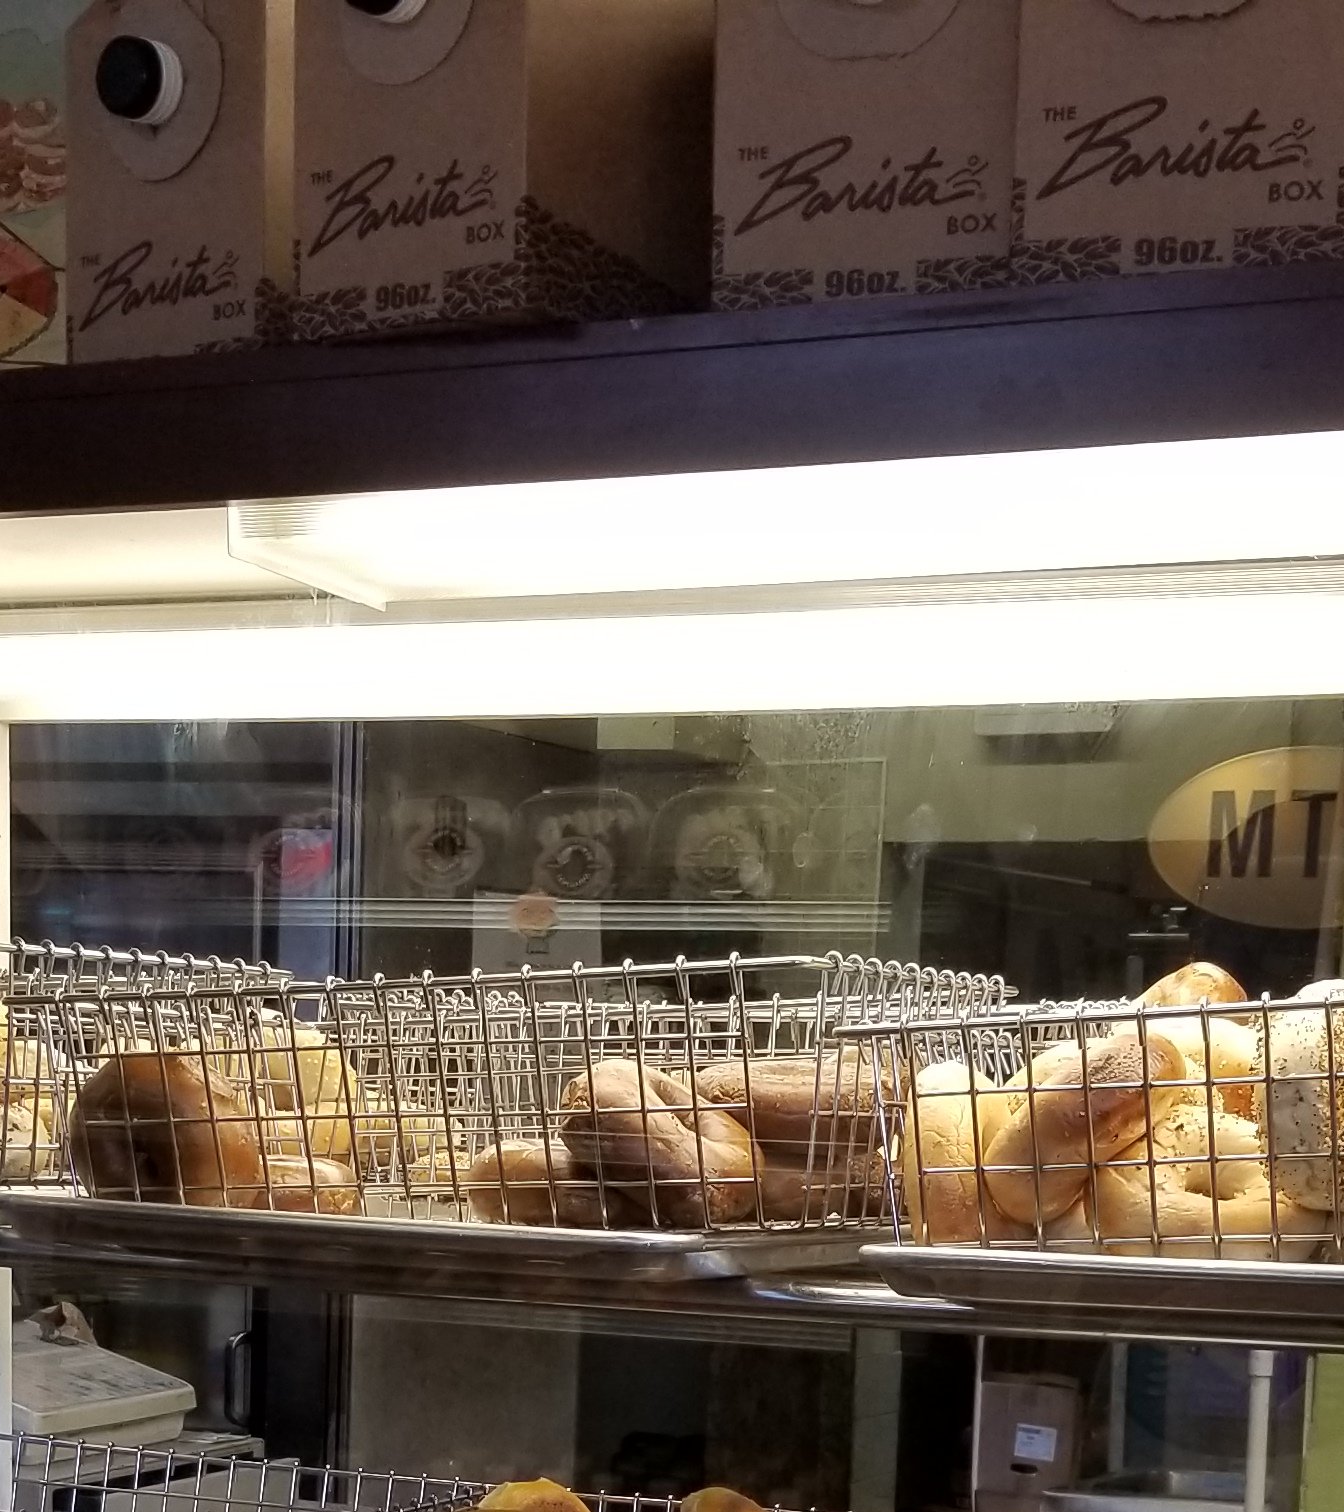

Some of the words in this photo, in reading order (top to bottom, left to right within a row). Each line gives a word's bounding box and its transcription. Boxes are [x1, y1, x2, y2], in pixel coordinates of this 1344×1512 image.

[1043, 104, 1078, 122] THE
[738, 145, 768, 161] THE
[1036, 95, 1284, 201] Barista
[310, 170, 333, 185] THE
[734, 135, 959, 236] Barista
[1268, 179, 1324, 204] BOX
[308, 154, 473, 258] Barista
[466, 221, 505, 244] BOX
[947, 212, 997, 236] BOX
[81, 255, 100, 267] THE
[1134, 234, 1224, 268] 96oz.
[79, 240, 220, 332] Barista
[825, 267, 906, 297] 96oz.
[375, 282, 436, 311] 96oz.
[213, 299, 246, 320] BOX
